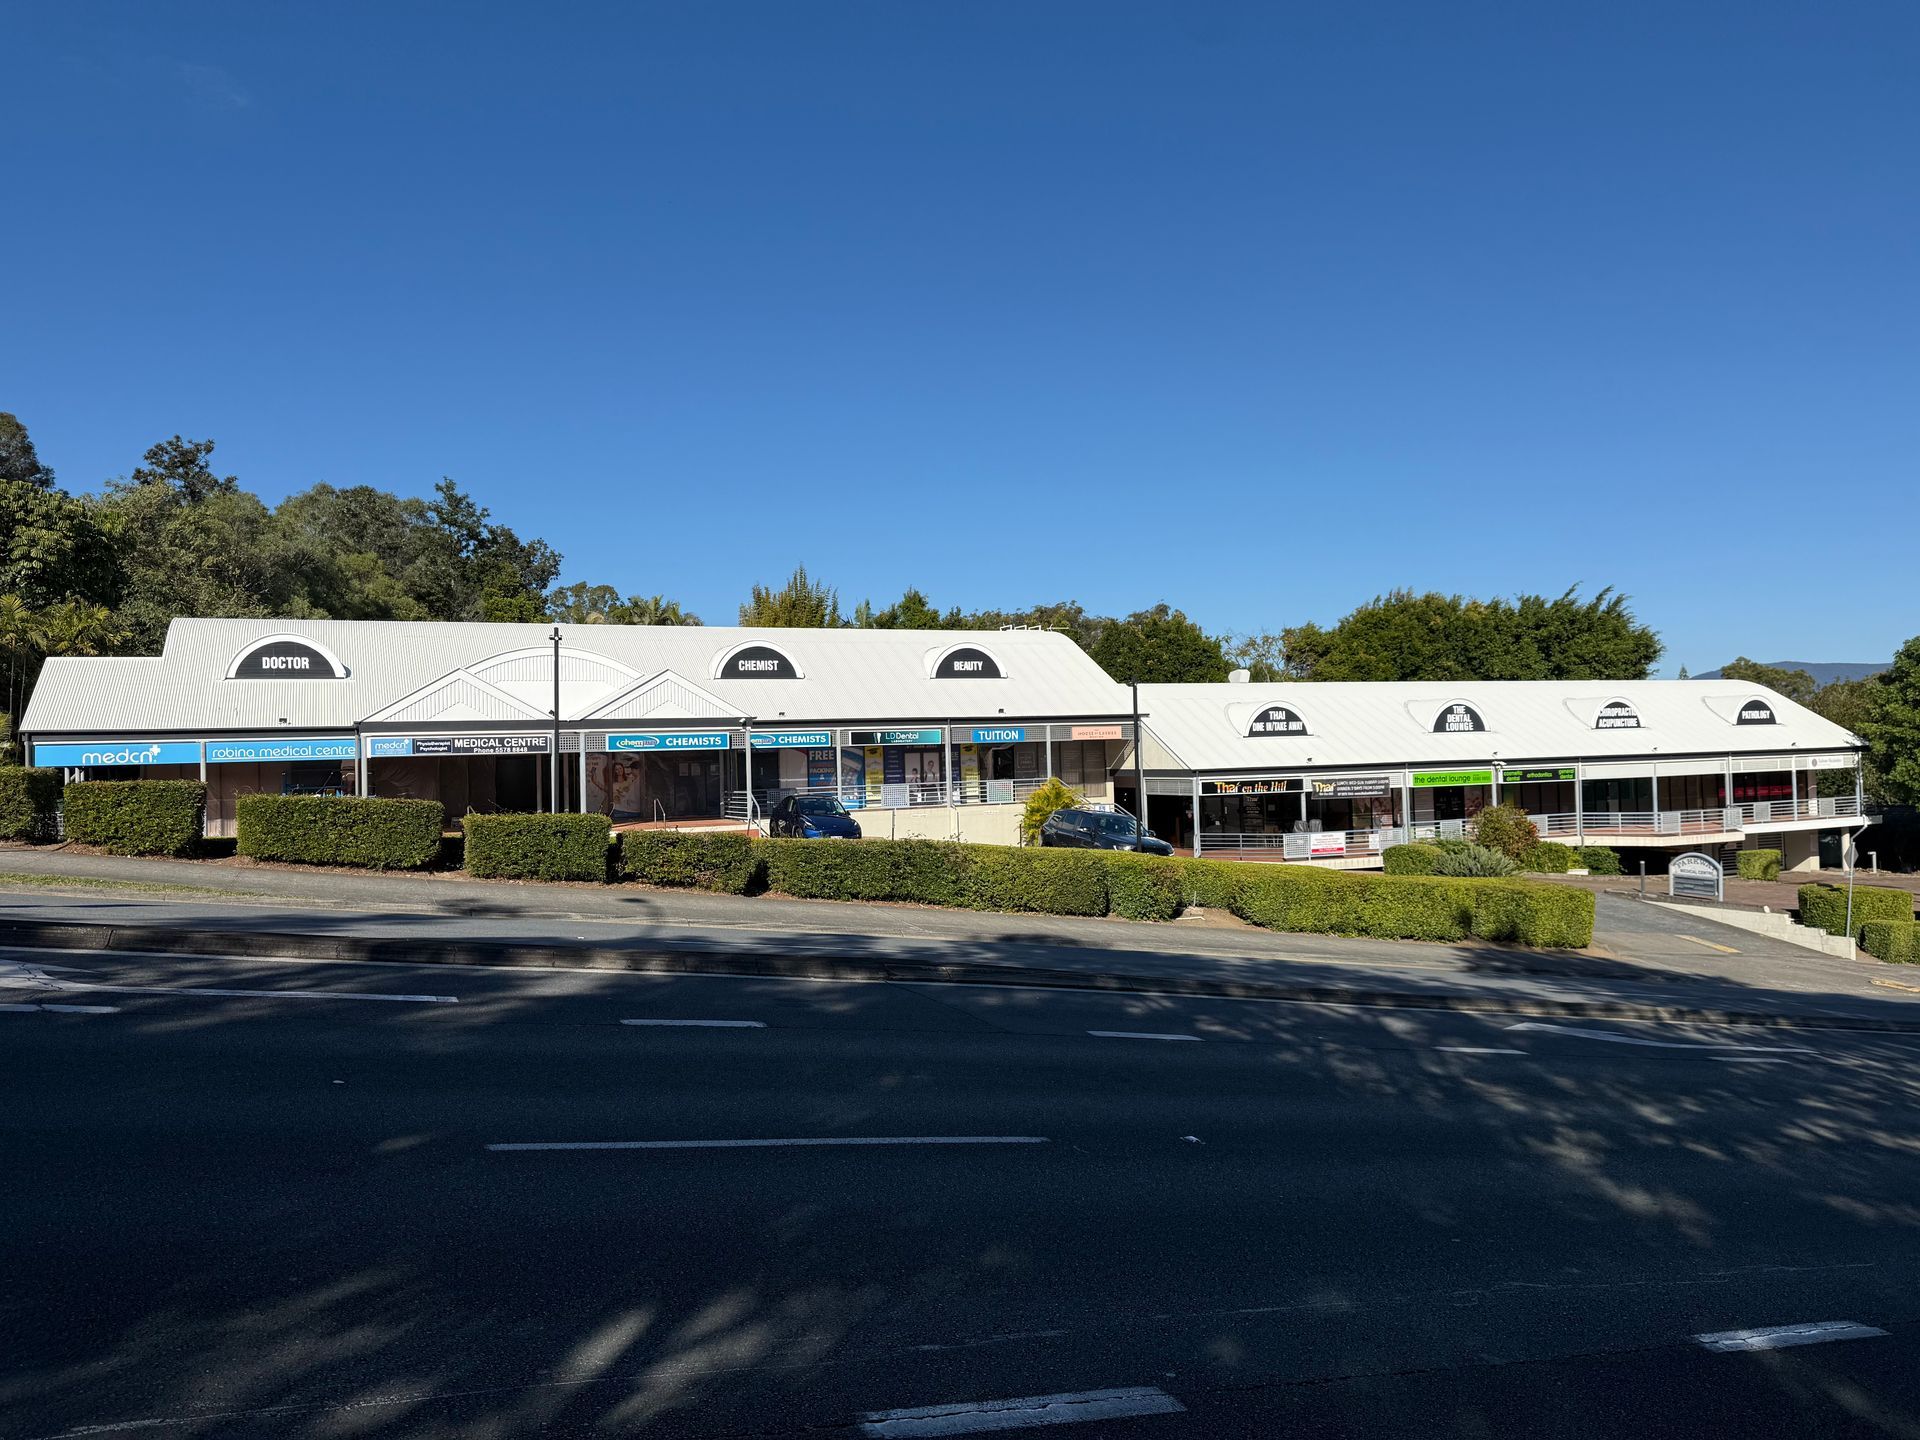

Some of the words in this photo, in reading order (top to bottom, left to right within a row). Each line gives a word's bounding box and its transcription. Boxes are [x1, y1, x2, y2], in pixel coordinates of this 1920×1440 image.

[262, 657, 310, 669] DOCTOR
[738, 660, 779, 671] CHEMIST
[953, 661, 983, 671] BEAUTY
[1453, 705, 1466, 714] THE
[1741, 710, 1771, 719] PATHOLOGY
[1268, 710, 1286, 720] THAI
[1446, 713, 1473, 723] DENTAL
[1288, 721, 1303, 731] AWAY
[1445, 722, 1475, 731] LOUNGE
[1598, 718, 1638, 727] ACUPUNCTURE
[778, 735, 827, 744] CHEMISTS
[895, 732, 919, 740] Dental
[978, 730, 1019, 740] TUITION
[454, 738, 502, 748] MEDICAL
[504, 737, 546, 747] CENTRE
[665, 736, 722, 746] CHEMISTS
[212, 747, 255, 758] robina
[259, 745, 312, 757] medical
[315, 745, 356, 756] centre
[809, 750, 835, 761] FREE
[1414, 776, 1425, 784] the
[1426, 775, 1448, 783] dental
[1449, 774, 1471, 784] lounge
[1214, 781, 1241, 794] Thai
[1254, 781, 1269, 793] the
[1270, 780, 1288, 792] Hill
[1312, 781, 1336, 793] Thai
